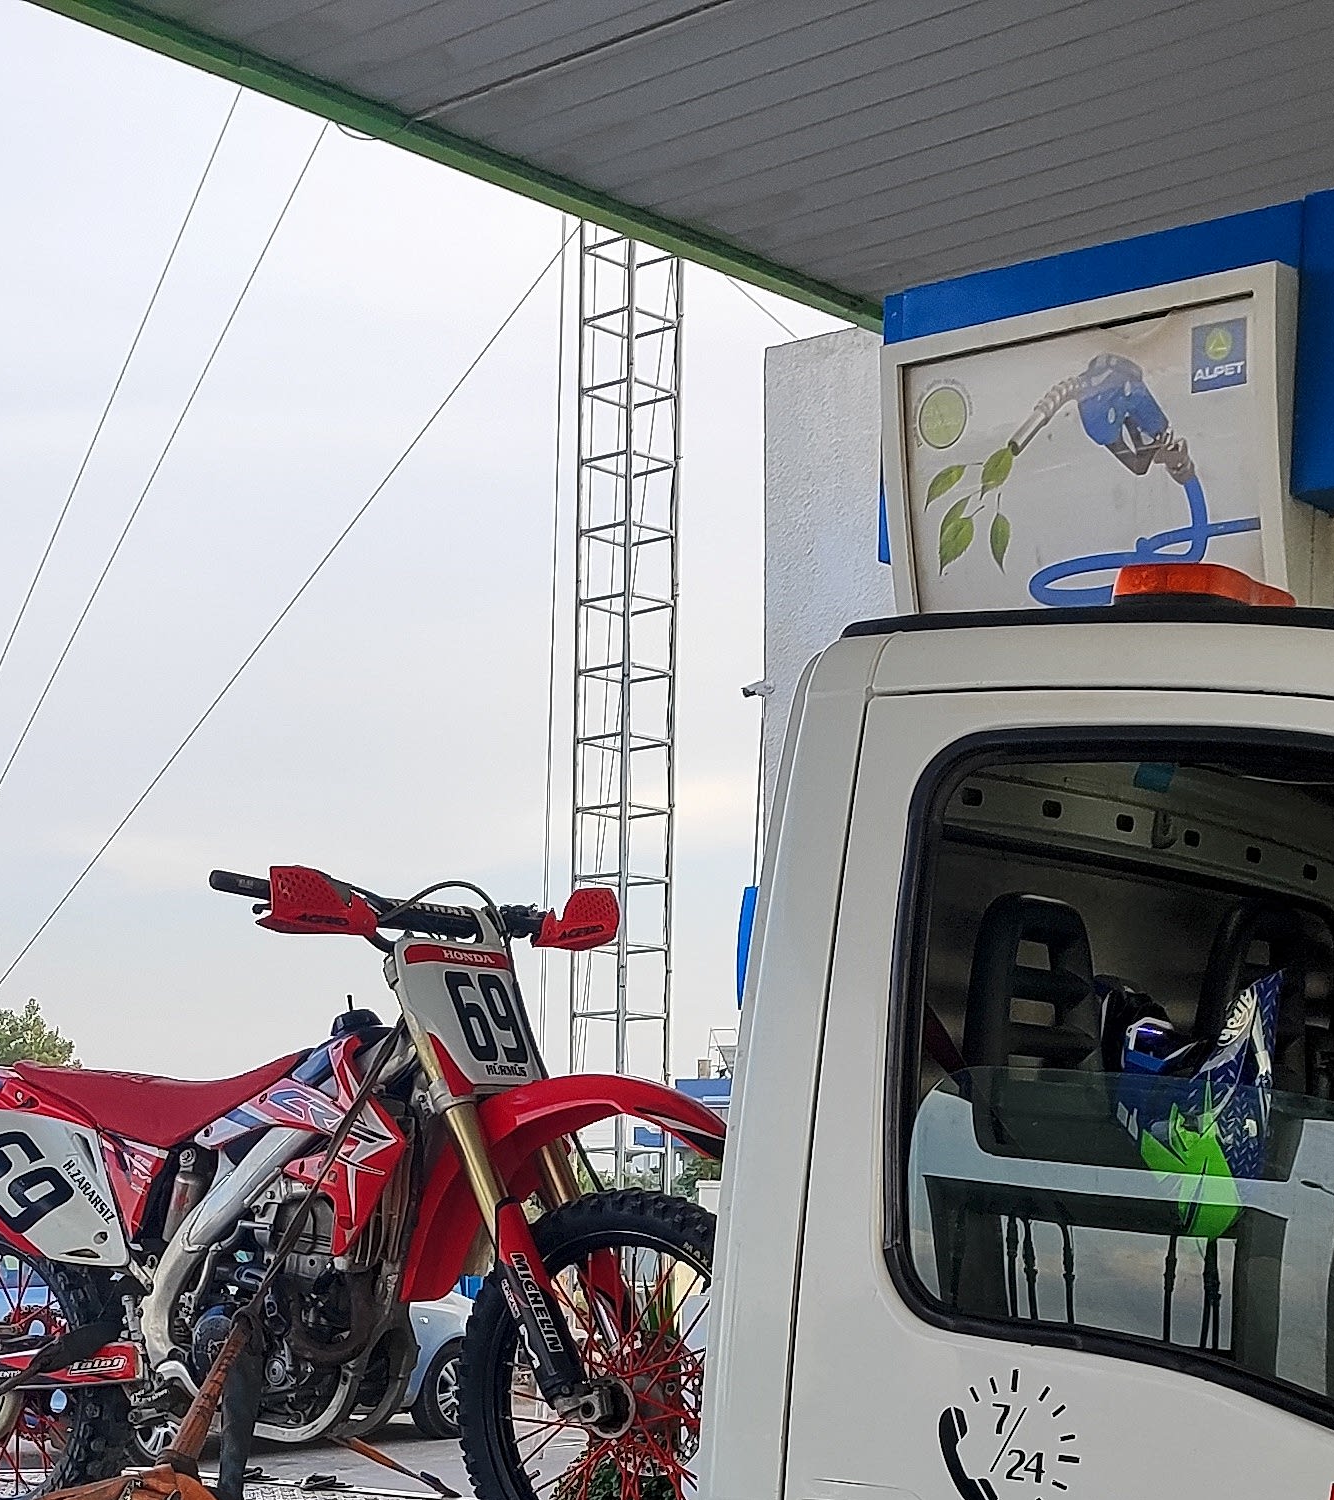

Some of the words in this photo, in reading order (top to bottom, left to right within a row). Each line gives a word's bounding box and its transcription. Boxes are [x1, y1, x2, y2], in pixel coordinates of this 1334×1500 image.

[1193, 361, 1245, 381] ALPET
[442, 949, 495, 964] HONDA
[444, 970, 529, 1064] 69
[510, 1252, 564, 1353] MICHELIN
